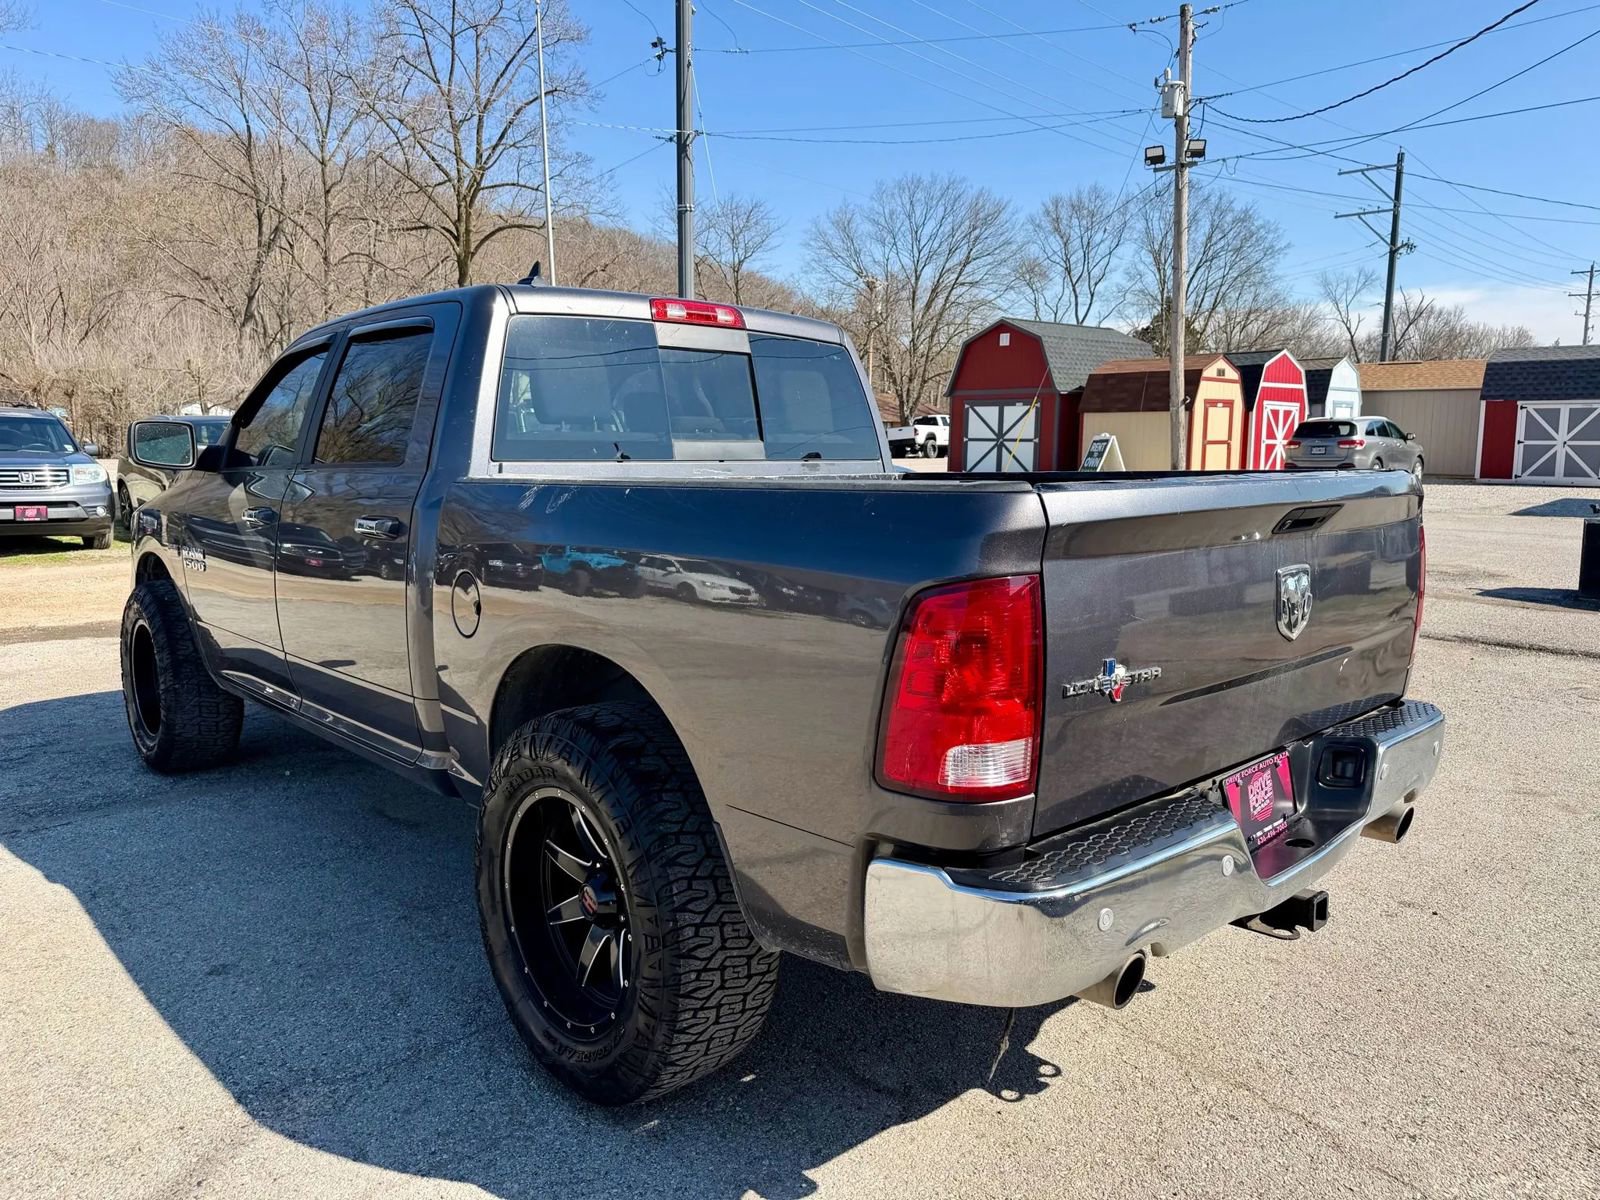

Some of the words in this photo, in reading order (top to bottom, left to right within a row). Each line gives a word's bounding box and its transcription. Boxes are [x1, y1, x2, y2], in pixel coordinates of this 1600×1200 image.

[1090, 442, 1107, 452] RENT
[1084, 457, 1101, 467] OWN
[1226, 775, 1241, 785] DRIVE
[1241, 766, 1258, 778] FORCE
[1259, 758, 1274, 770] AUTO
[1273, 751, 1289, 763] PLAZA
[502, 766, 557, 800] RADAR
[1248, 768, 1272, 799] DRIVE
[1249, 787, 1273, 814] FORCE
